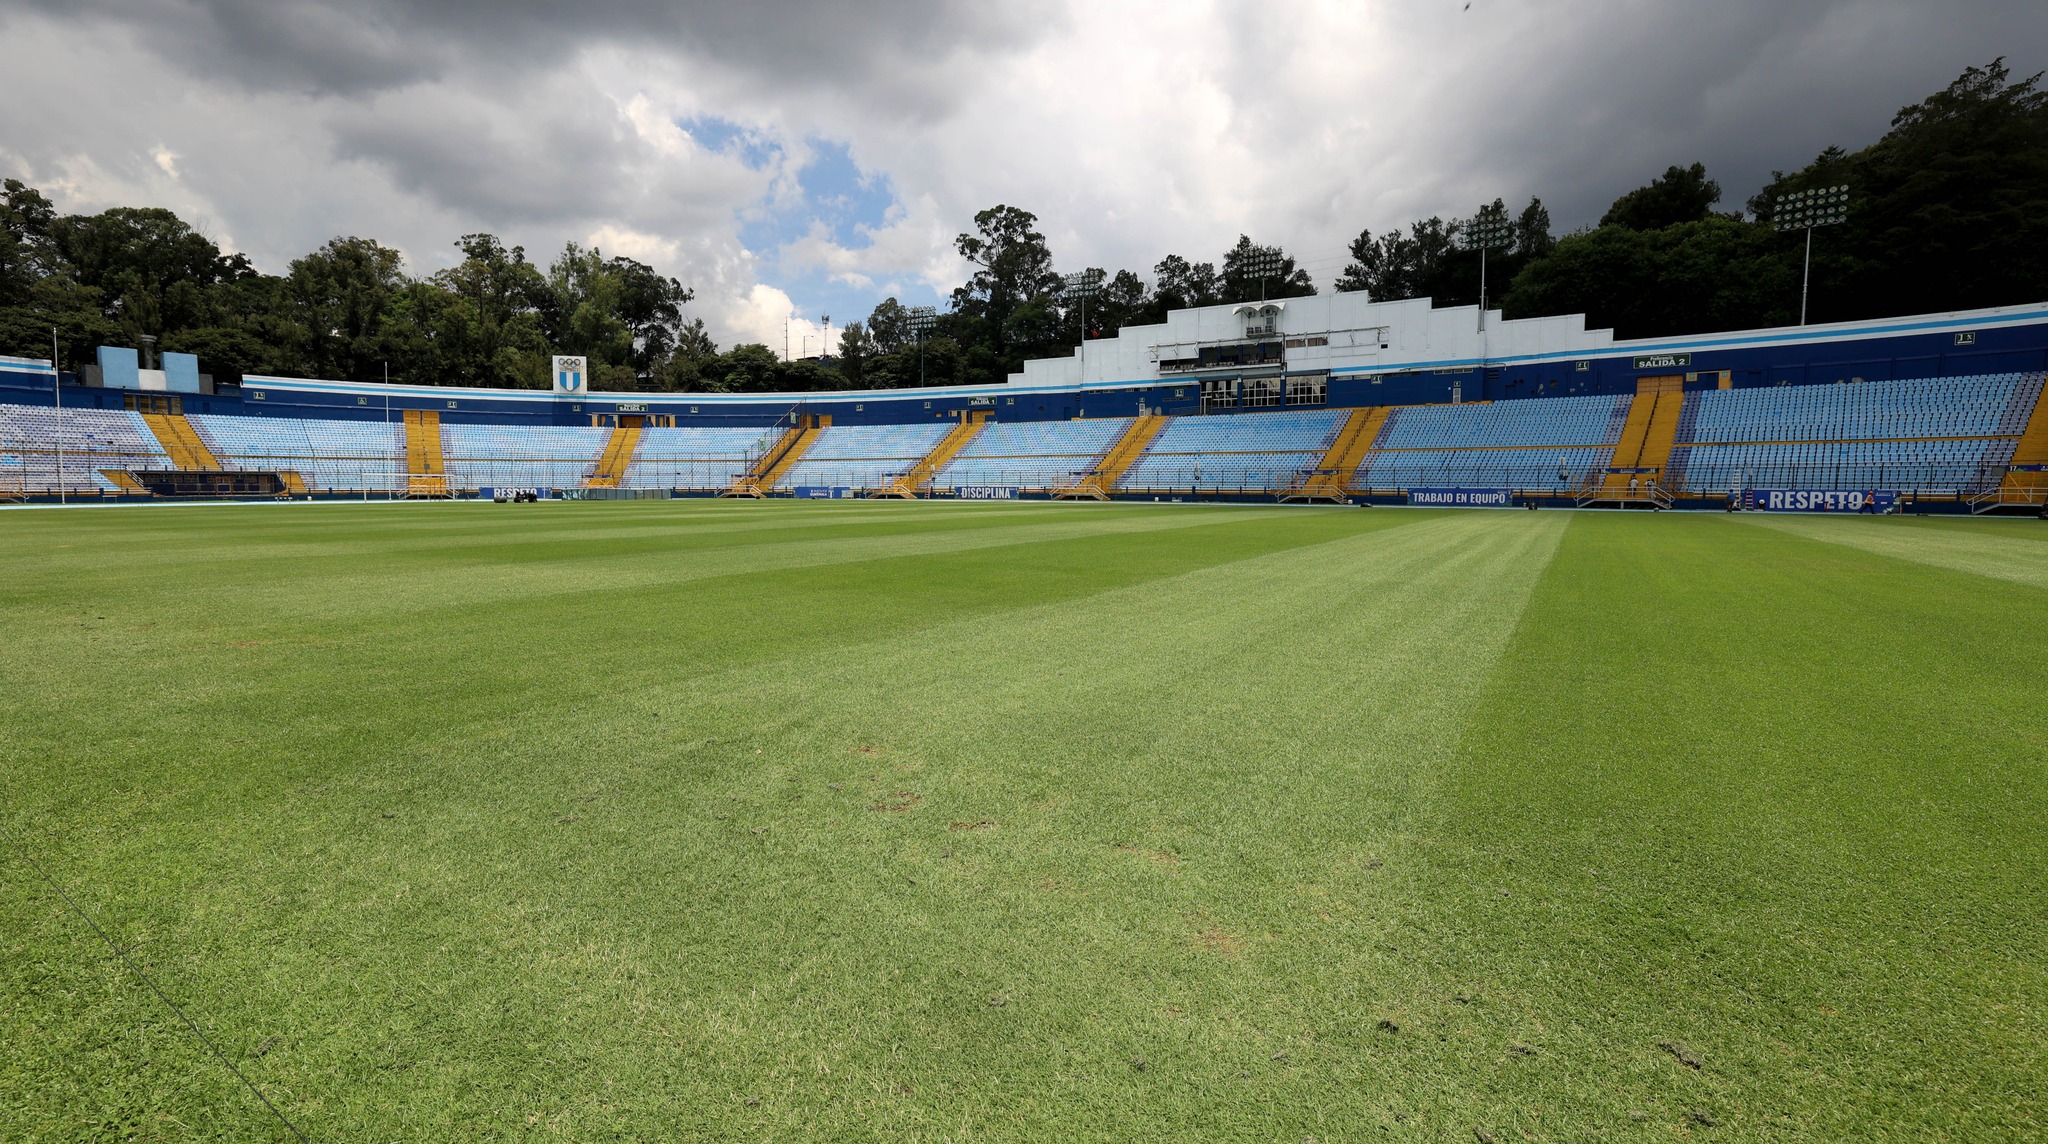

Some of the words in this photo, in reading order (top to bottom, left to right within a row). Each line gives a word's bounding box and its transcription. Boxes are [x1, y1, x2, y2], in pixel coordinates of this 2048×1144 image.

[1638, 359, 1676, 368] SALIDA
[961, 487, 1011, 499] DISCIPLINA
[1413, 492, 1453, 503] TRABAJO
[1456, 493, 1467, 503] EN
[1470, 493, 1506, 504] EQUIPO
[1769, 491, 1863, 510] RESPETO
